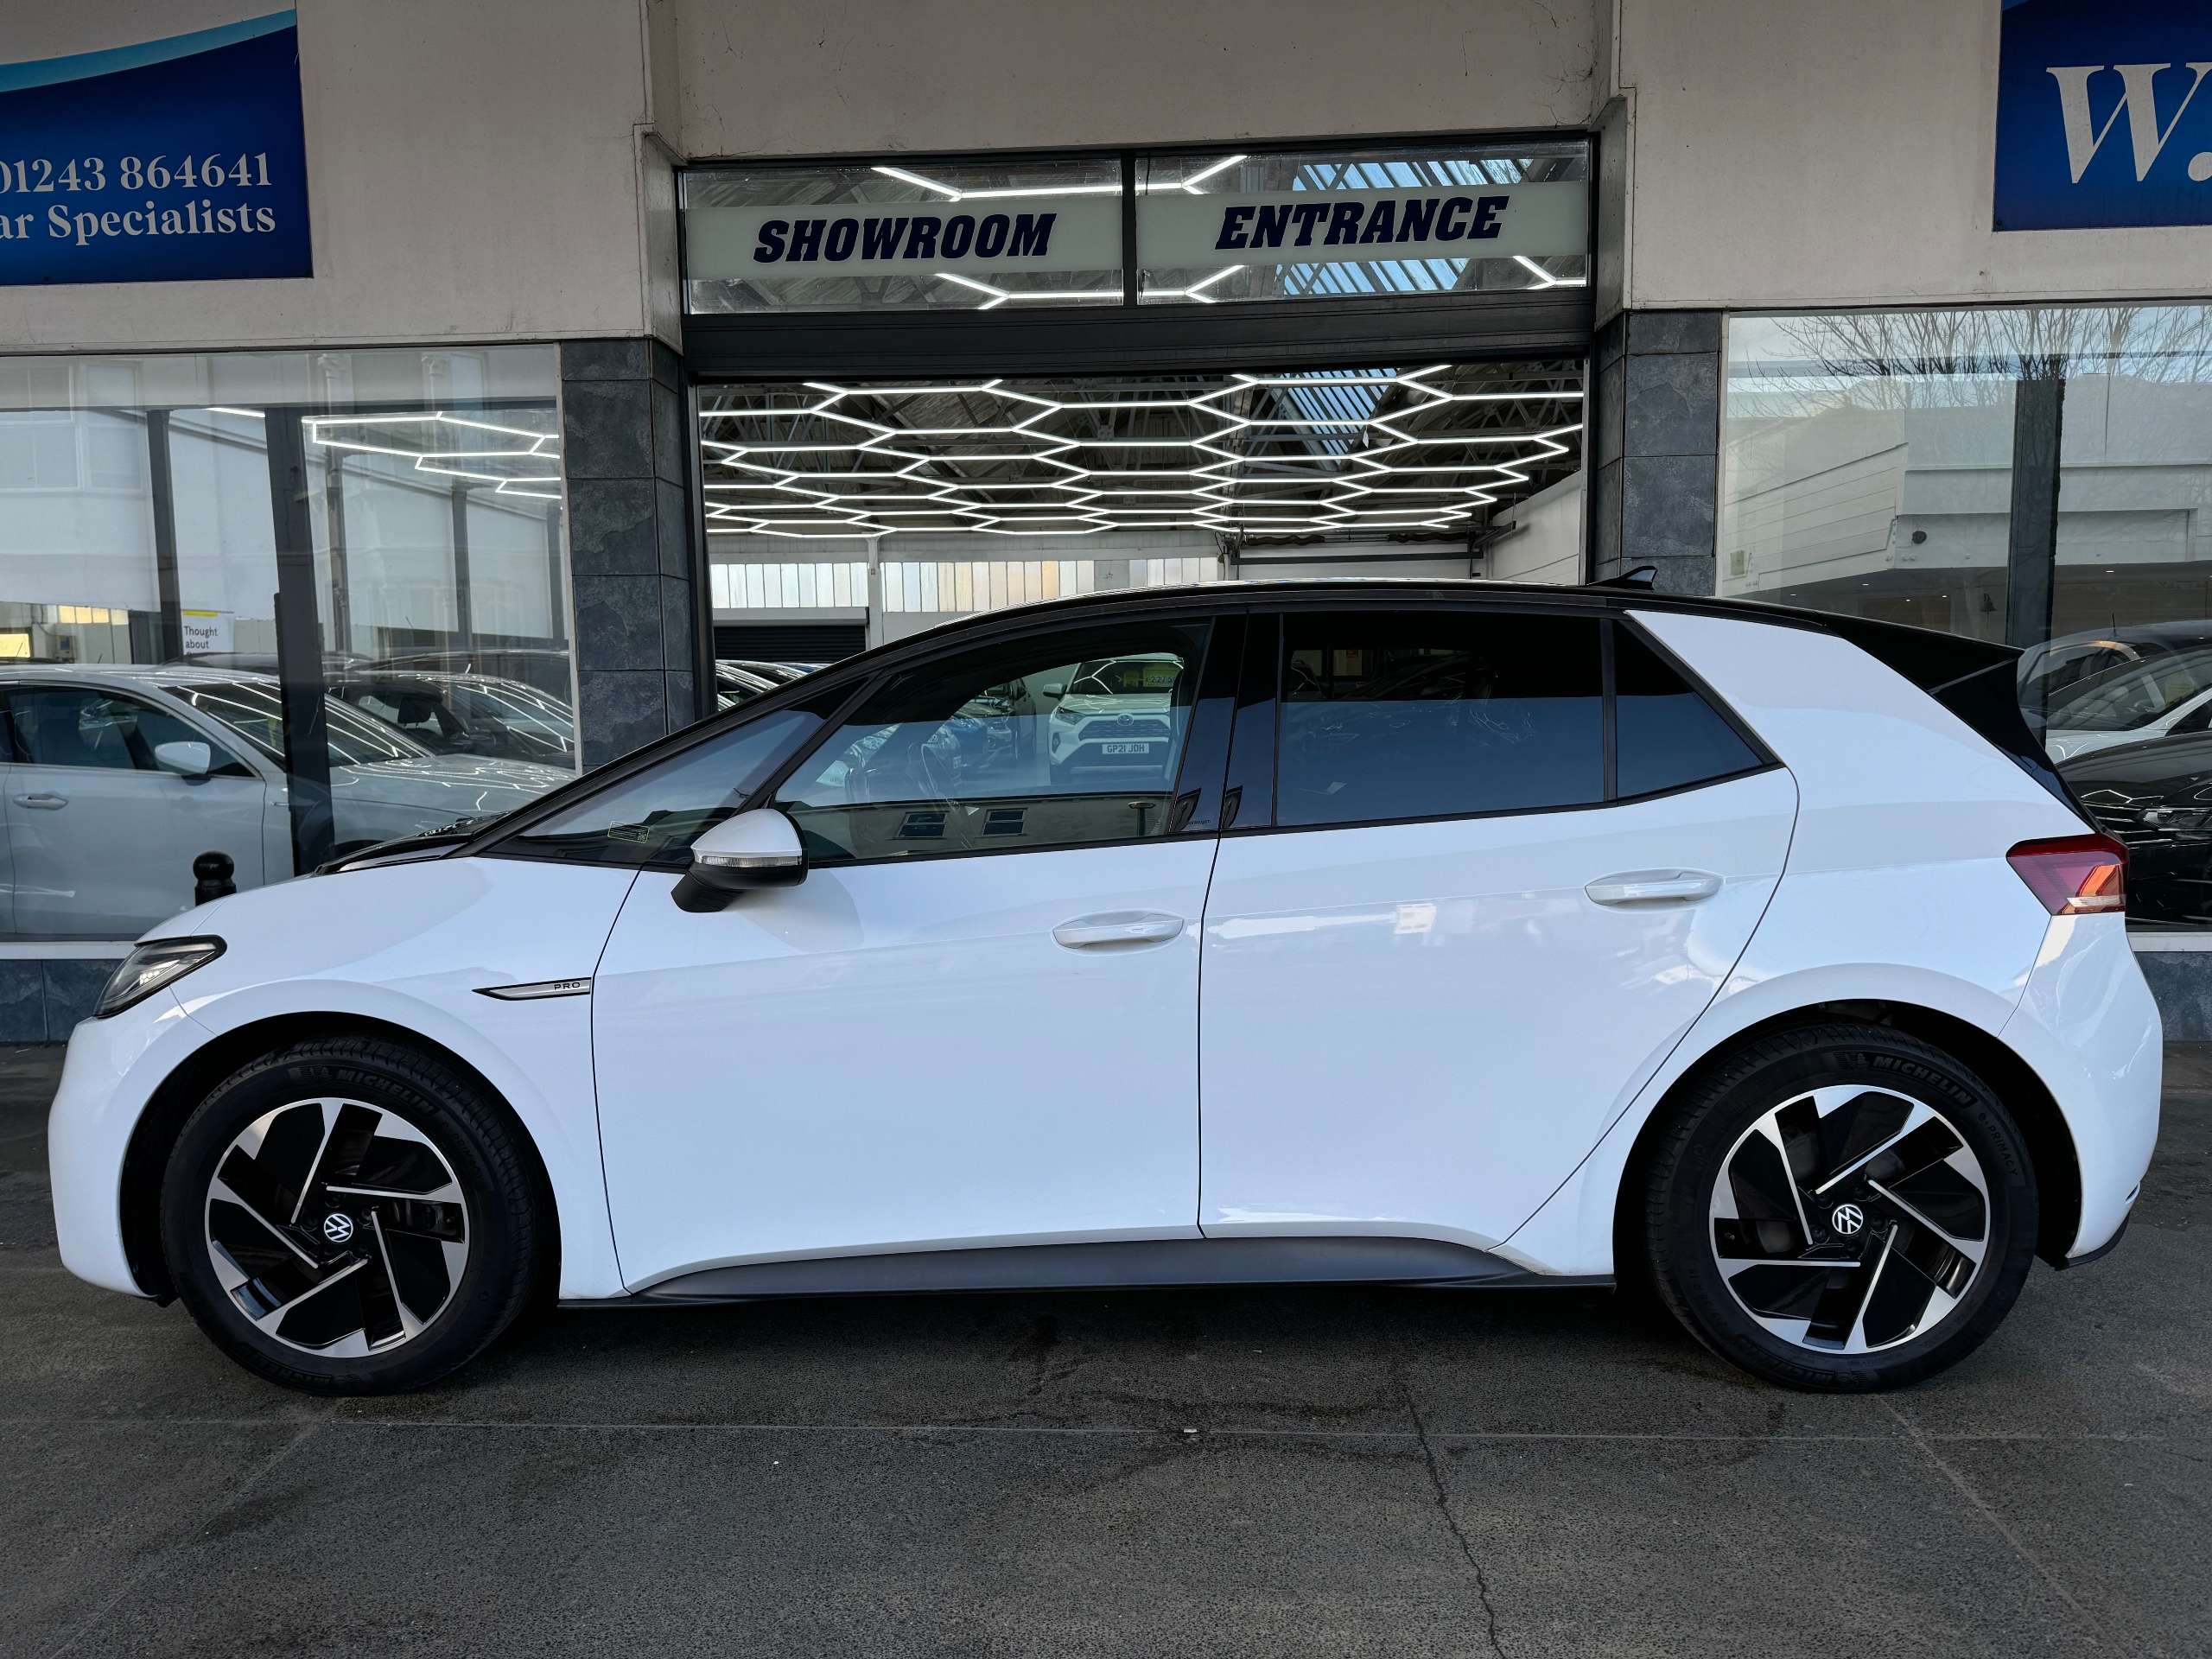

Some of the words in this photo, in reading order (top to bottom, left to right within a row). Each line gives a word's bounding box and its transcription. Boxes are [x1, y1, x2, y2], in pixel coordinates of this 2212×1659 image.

[120, 151, 273, 190] 864641
[48, 199, 276, 246] Specialists
[753, 213, 1058, 264] SHOWROOM
[1214, 195, 1510, 251] ENTRANCE
[183, 625, 219, 639] Thought
[185, 639, 210, 650] about
[1107, 744, 1127, 753] GP21
[553, 982, 582, 991] PRO
[334, 1068, 437, 1116] MICHELIN
[1872, 1055, 1973, 1107] MICHELIN
